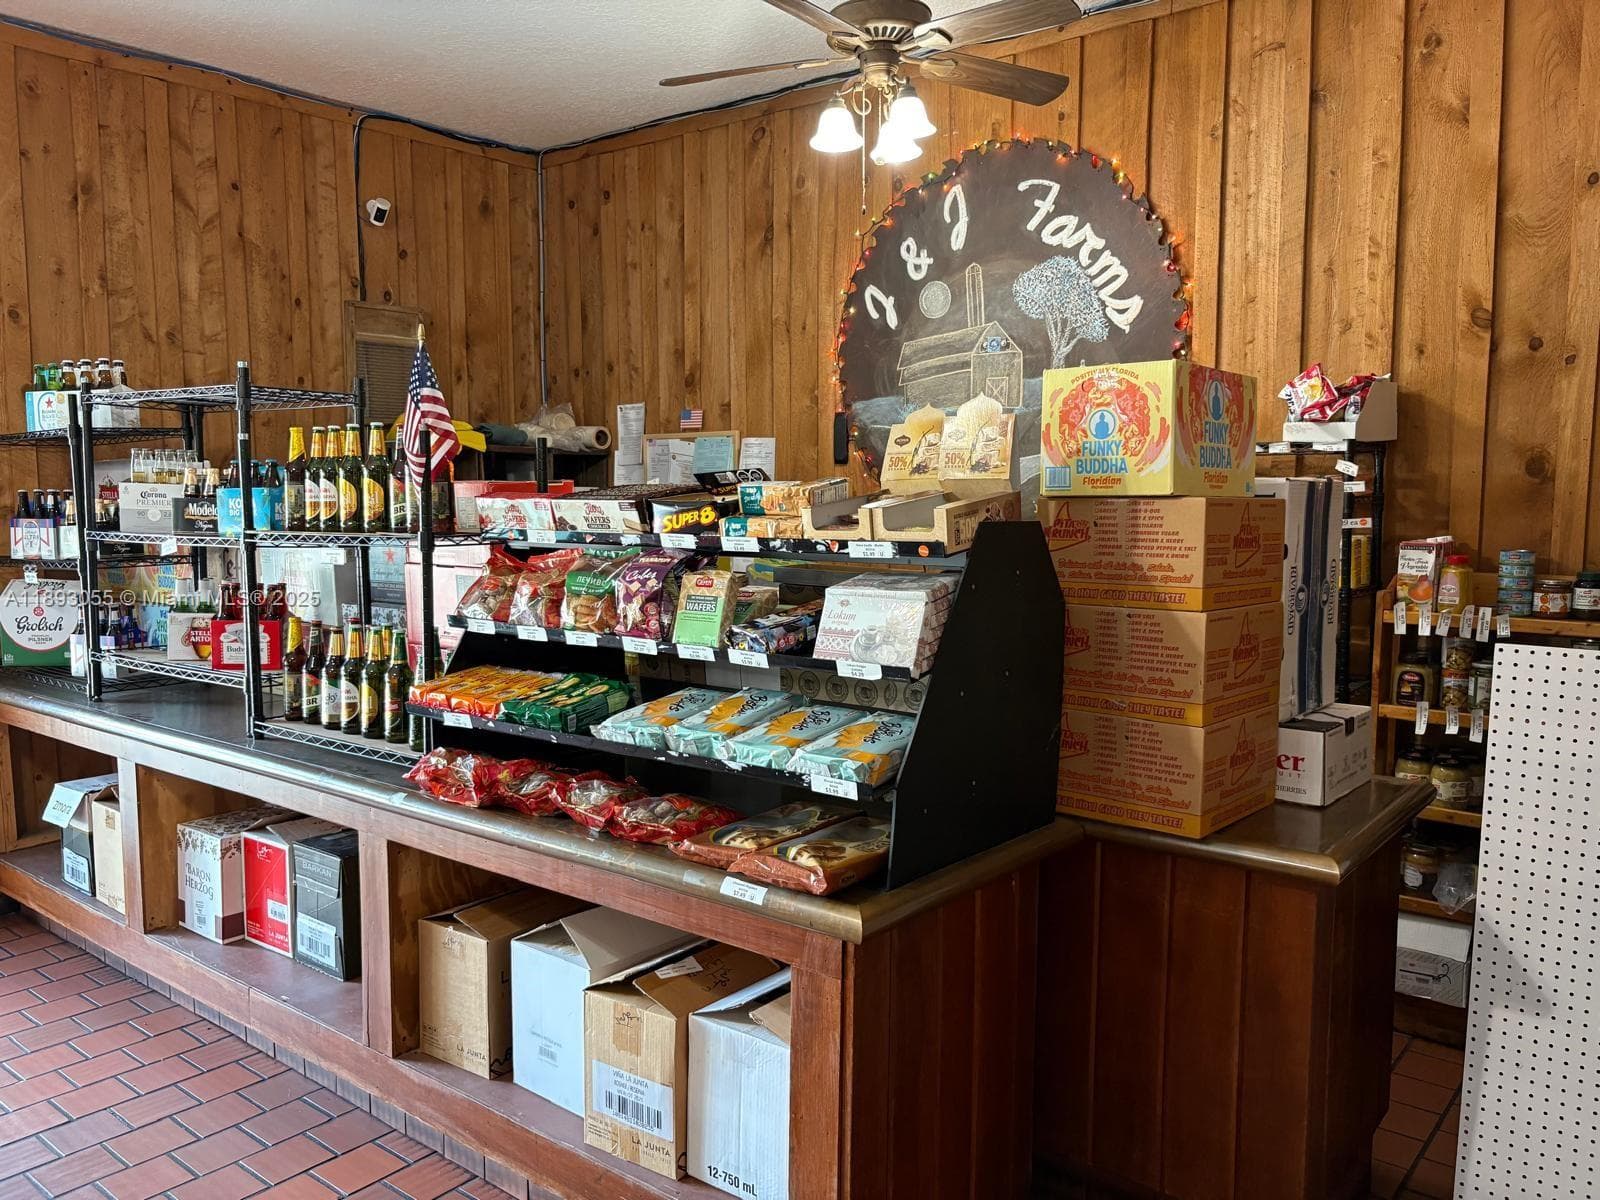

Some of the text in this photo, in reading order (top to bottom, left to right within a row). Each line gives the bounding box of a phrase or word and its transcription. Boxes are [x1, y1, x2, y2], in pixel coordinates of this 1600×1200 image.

[900, 237, 933, 281] &
[944, 184, 968, 251] J
[1018, 179, 1144, 334] Farms
[1204, 421, 1229, 445] FUNKY
[1081, 440, 1123, 456] FUNKY
[888, 457, 907, 468] 50%
[944, 452, 965, 465] 50%
[1076, 457, 1128, 474] BUDDHA
[1200, 446, 1232, 469] BUDDHA
[1082, 476, 1121, 486] Floridian
[1203, 471, 1228, 483] Floridian
[141, 490, 167, 499] Corona
[583, 516, 610, 524] WAFERS
[662, 506, 716, 532] SUPER 8
[1078, 587, 1185, 604] HOW GOOD THEY TASTE!
[686, 603, 716, 612] WAFERS
[828, 610, 856, 621] Lokum
[15, 616, 64, 634] Grolsch
[1128, 702, 1151, 714] THEY
[1153, 705, 1185, 719] TASTE!
[1126, 808, 1150, 822] THEY
[1151, 814, 1183, 829] TASTE!
[186, 863, 211, 883] BARON
[303, 861, 332, 878] BARKAN
[185, 875, 214, 900] HERZOG
[457, 1043, 486, 1062] LA JUNTA
[626, 1075, 632, 1083] LA
[632, 1078, 649, 1089] JUNTA
[632, 1135, 671, 1156] LA JUNTA
[708, 1165, 758, 1198] 12-750 mL
